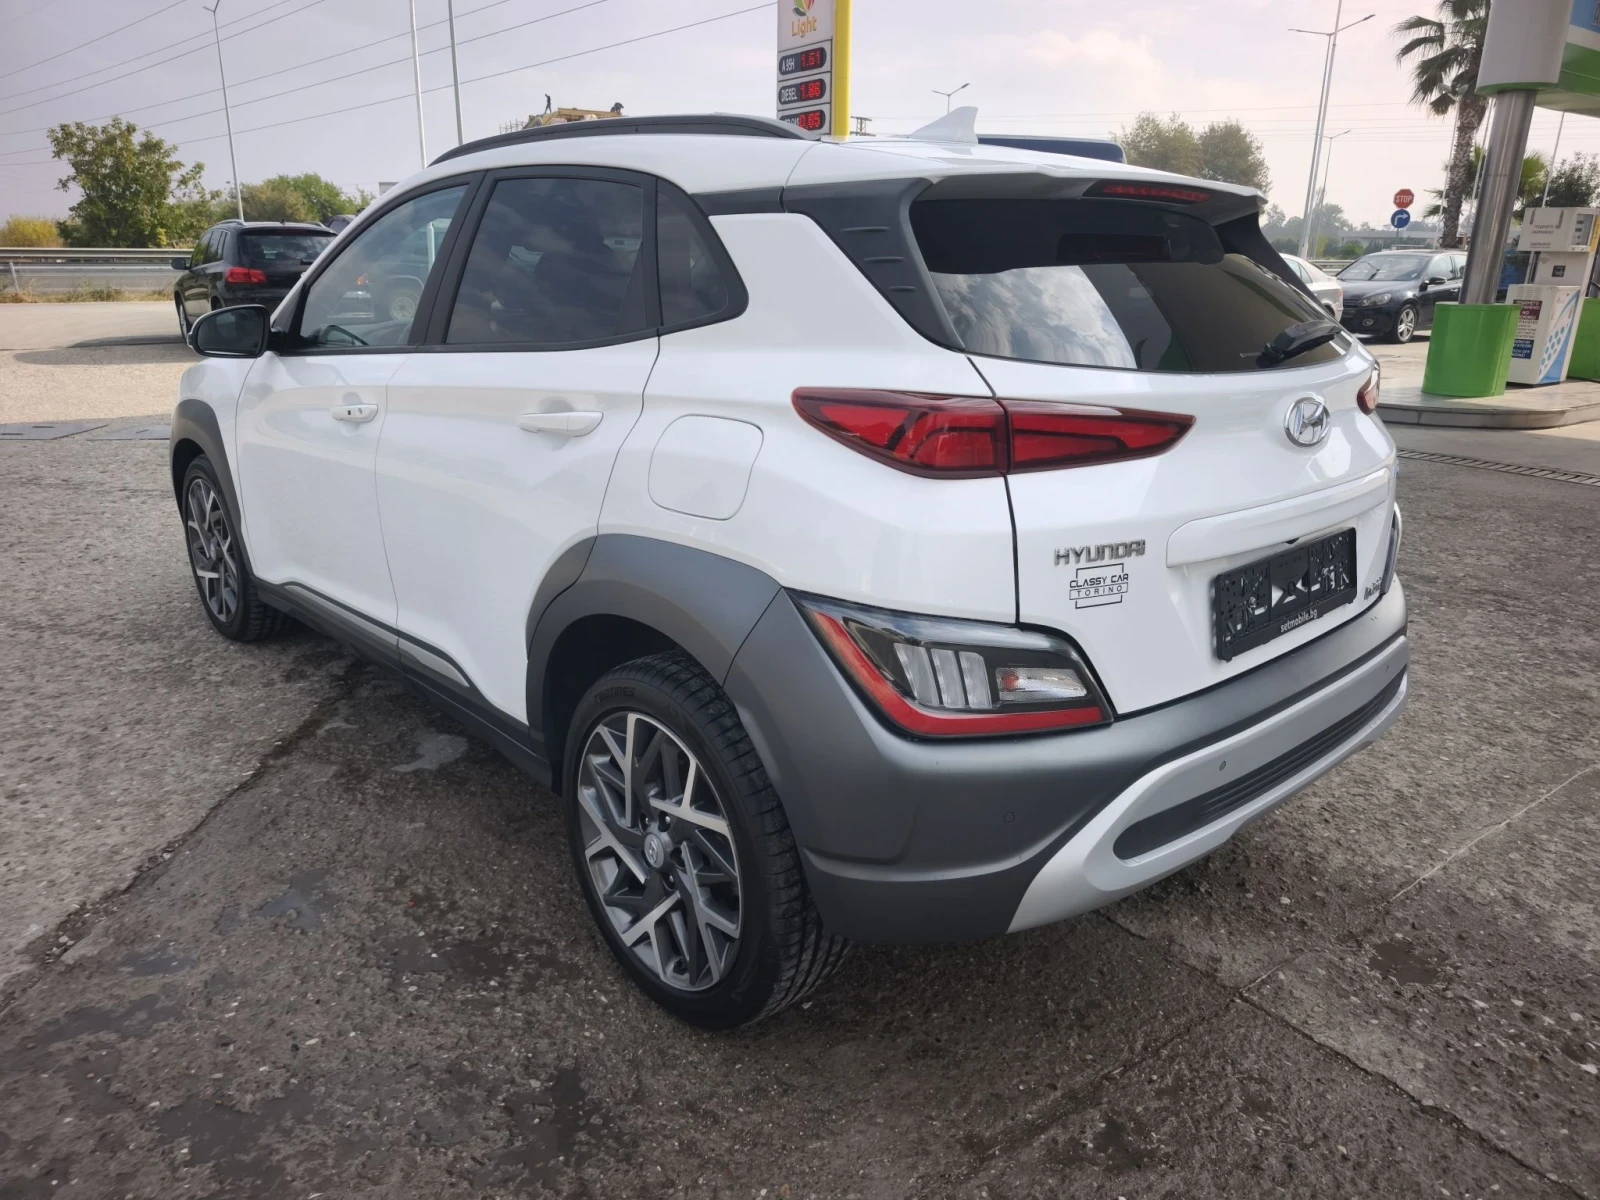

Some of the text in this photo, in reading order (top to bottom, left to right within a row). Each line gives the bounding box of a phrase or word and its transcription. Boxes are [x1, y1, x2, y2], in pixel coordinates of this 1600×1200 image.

[791, 16, 817, 38] Light
[781, 87, 797, 102] DIESEL
[1396, 195, 1413, 203] STOP
[1053, 539, 1146, 566] HYUNDAI
[1069, 573, 1129, 588] CLASSY CAR
[1076, 585, 1123, 597] TORINO
[1280, 608, 1318, 633] setmobile.bg
